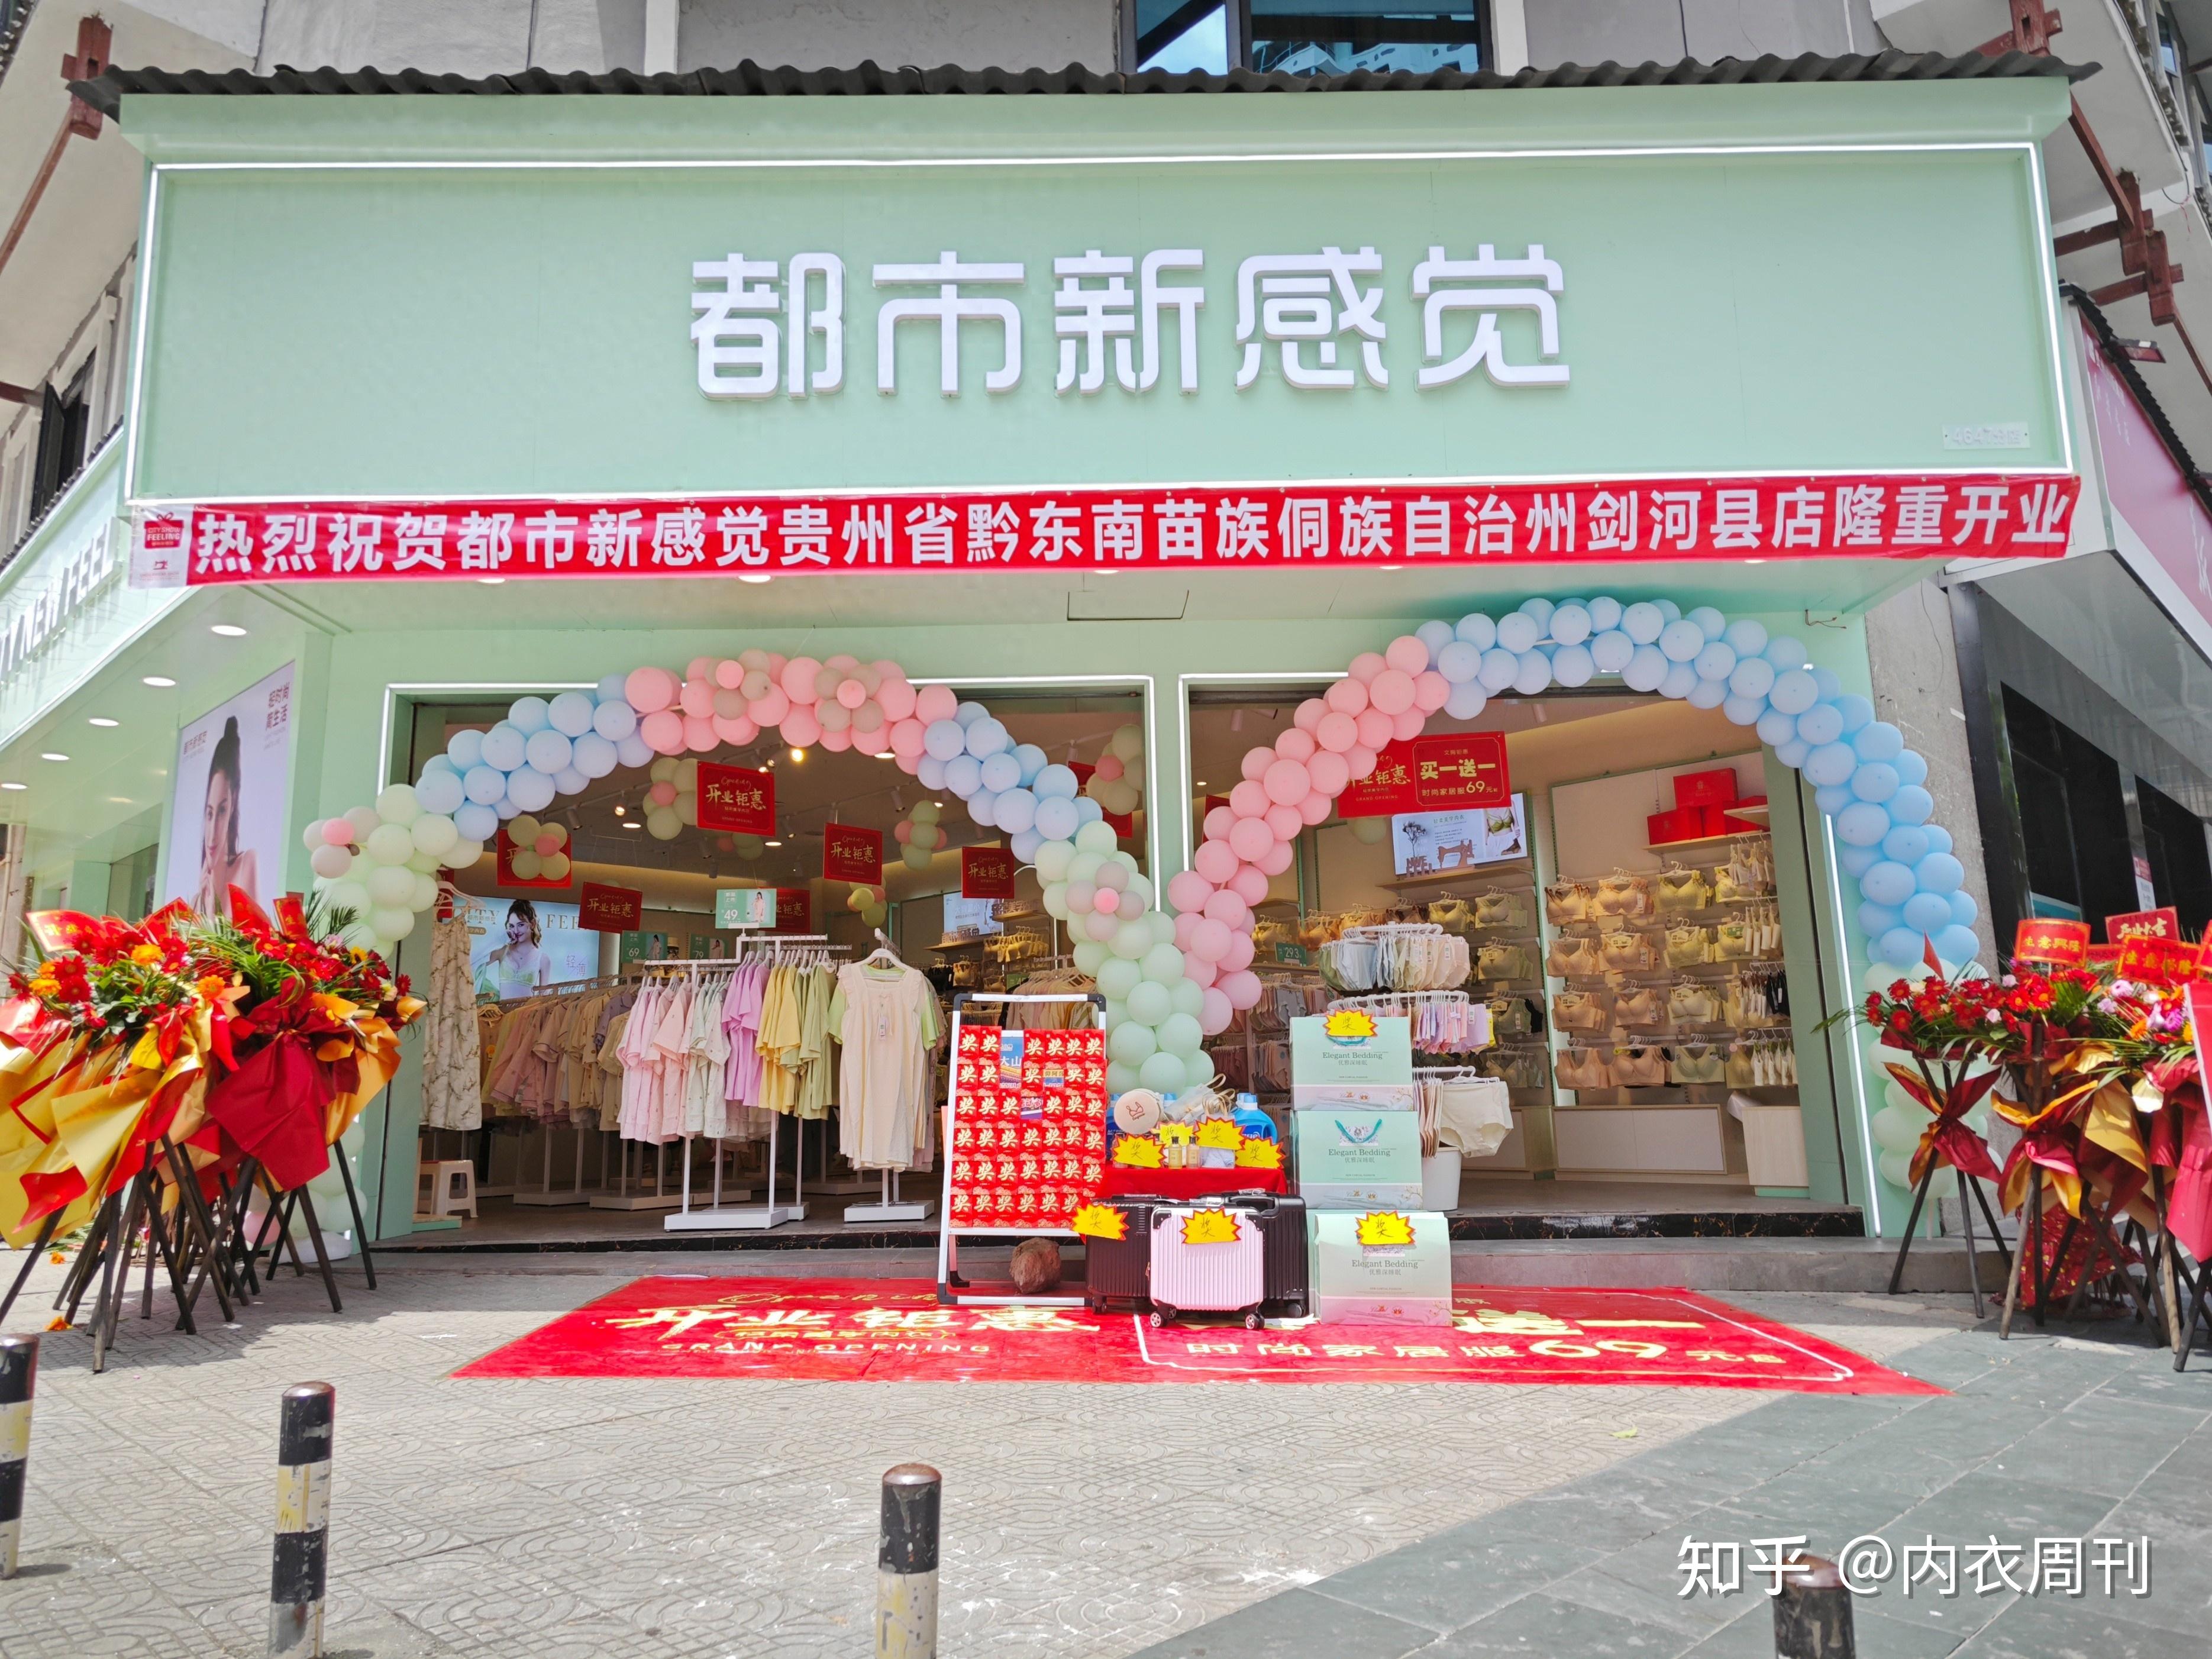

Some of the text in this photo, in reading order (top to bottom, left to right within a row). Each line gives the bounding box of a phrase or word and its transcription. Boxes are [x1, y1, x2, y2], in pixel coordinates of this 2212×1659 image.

[691, 244, 1570, 400] 都市新感觉
[196, 483, 2069, 573] 热烈祝贺都市新感觉贵州省黔东南苗族侗族自治州剑河县店隆重开业
[63, 521, 120, 618] FEEL
[1420, 759, 1496, 780] 买一送一
[706, 783, 767, 811] 开业钜惠
[831, 841, 876, 863] 开业钜惠
[968, 863, 1009, 880] 开业钜惠
[587, 898, 634, 918] 开业钜惠
[724, 909, 738, 921] 49
[777, 902, 805, 916] 钜惠
[628, 948, 640, 957] 69
[695, 950, 704, 958] 79
[959, 1034, 977, 1052] 奖
[980, 1034, 1000, 1052] 奖
[1025, 1038, 1044, 1056] 奖
[1046, 1038, 1064, 1056] 奖
[1065, 1038, 1083, 1056] 奖
[1084, 1037, 1103, 1056] 奖
[1322, 1051, 1383, 1060] Elegant Bedding
[958, 1065, 977, 1083] 奖
[979, 1065, 998, 1083] 奖
[1022, 1067, 1041, 1084] 奖
[1065, 1069, 1084, 1083] 奖
[1086, 1069, 1104, 1086] 奖
[957, 1096, 976, 1115] 奖
[979, 1096, 997, 1115] 奖
[1000, 1096, 1019, 1115] 奖
[1044, 1096, 1063, 1114] 奖
[1065, 1095, 1084, 1113] 奖
[1086, 1099, 1105, 1117] 奖
[954, 1128, 974, 1147] 奖
[976, 1128, 996, 1147] 奖
[999, 1129, 1018, 1148] 奖
[1022, 1128, 1041, 1147] 奖
[1043, 1128, 1062, 1147] 奖
[1064, 1127, 1083, 1145] 奖
[1084, 1131, 1103, 1150] 奖
[1328, 1148, 1391, 1157] Elegant Bedding
[952, 1161, 972, 1180] 奖
[975, 1161, 995, 1180] 奖
[997, 1161, 1017, 1181] 奖
[1020, 1160, 1039, 1179] 奖
[1041, 1160, 1061, 1179] 奖
[1063, 1160, 1082, 1179] 奖
[1083, 1164, 1103, 1183] 奖
[951, 1195, 971, 1212] 奖
[974, 1195, 993, 1213] 奖
[994, 1195, 1015, 1213] 奖
[1017, 1194, 1036, 1213] 奖
[1039, 1193, 1059, 1212] 奖
[1061, 1193, 1080, 1213] 奖
[1351, 1259, 1419, 1269] Elegant Bedding
[605, 1305, 1100, 1341] 开业钜惠
[814, 1342, 990, 1353] OPENING
